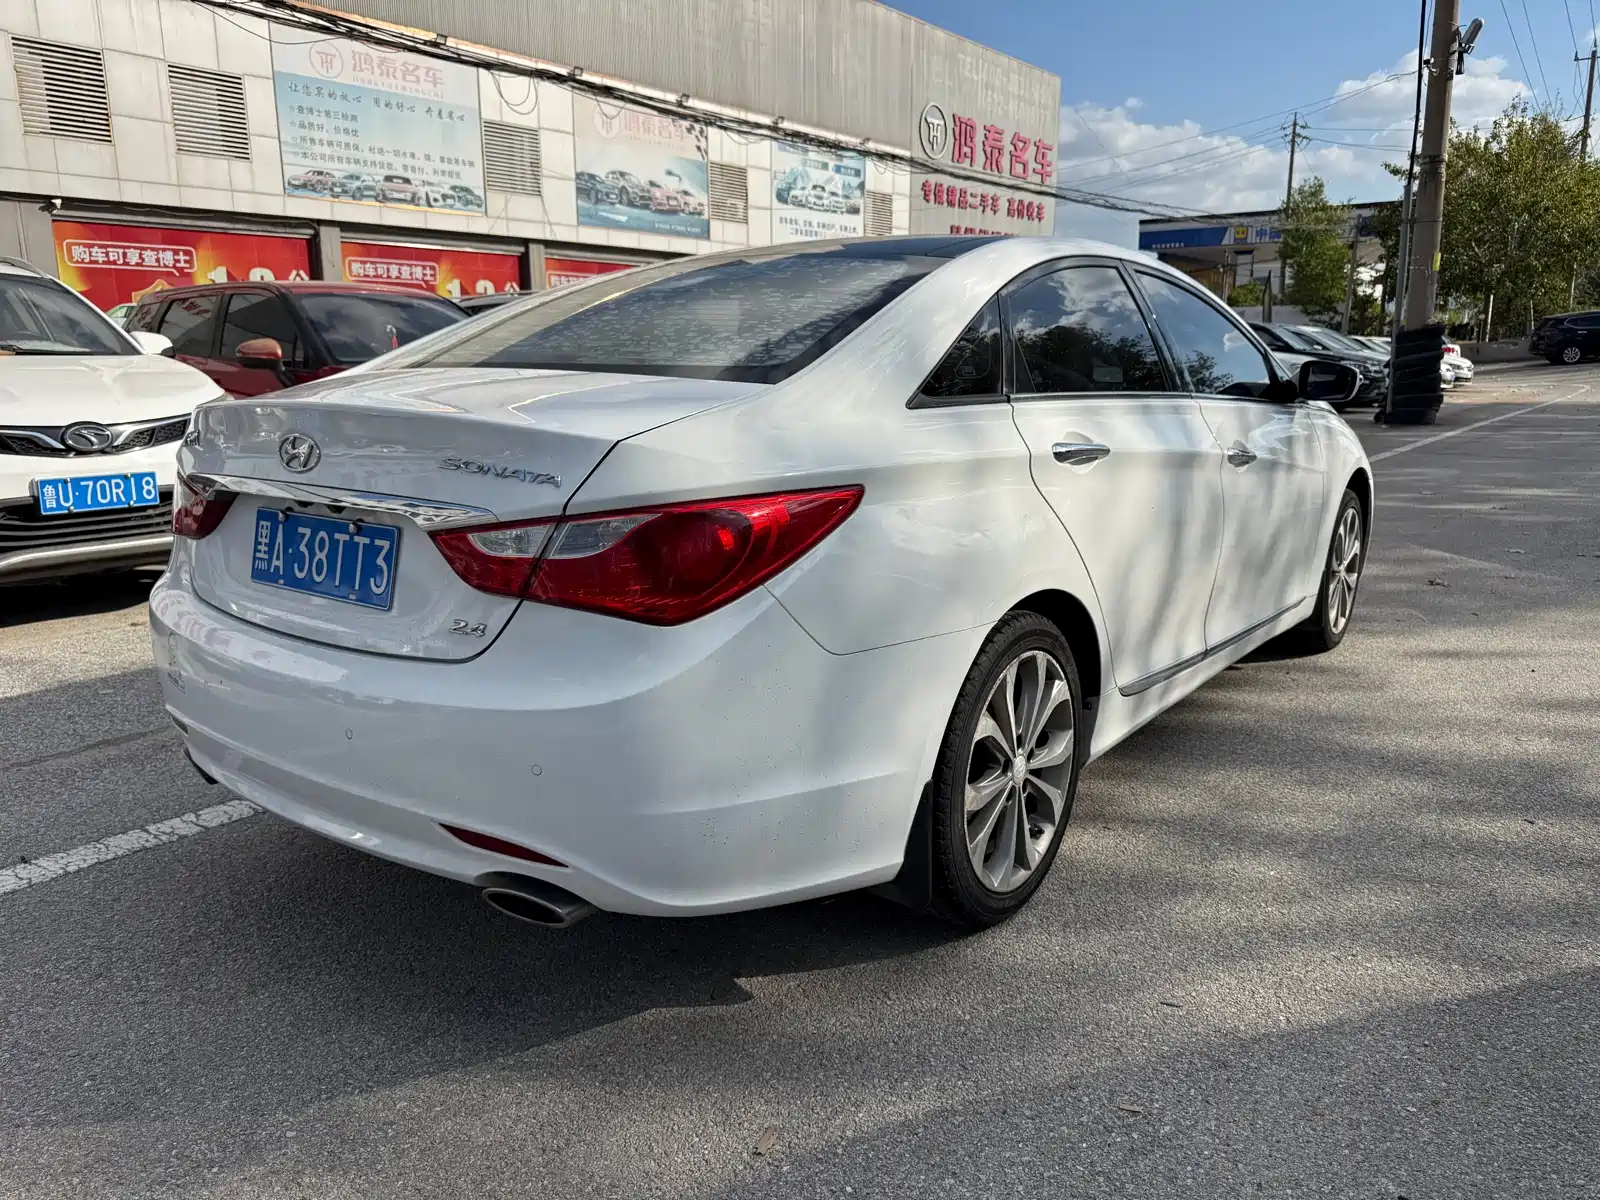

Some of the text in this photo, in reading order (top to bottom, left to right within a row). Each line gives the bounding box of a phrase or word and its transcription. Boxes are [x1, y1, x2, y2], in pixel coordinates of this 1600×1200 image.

[351, 50, 445, 88] 鸿泰名车
[952, 113, 1055, 184] 鸿泰名车
[1007, 197, 1045, 223] 高价收车
[71, 245, 191, 269] 购车可享查博士
[351, 262, 435, 281] 购车可享查博士
[437, 458, 562, 488] SONATA
[254, 521, 390, 595] 黑A·38TT3
